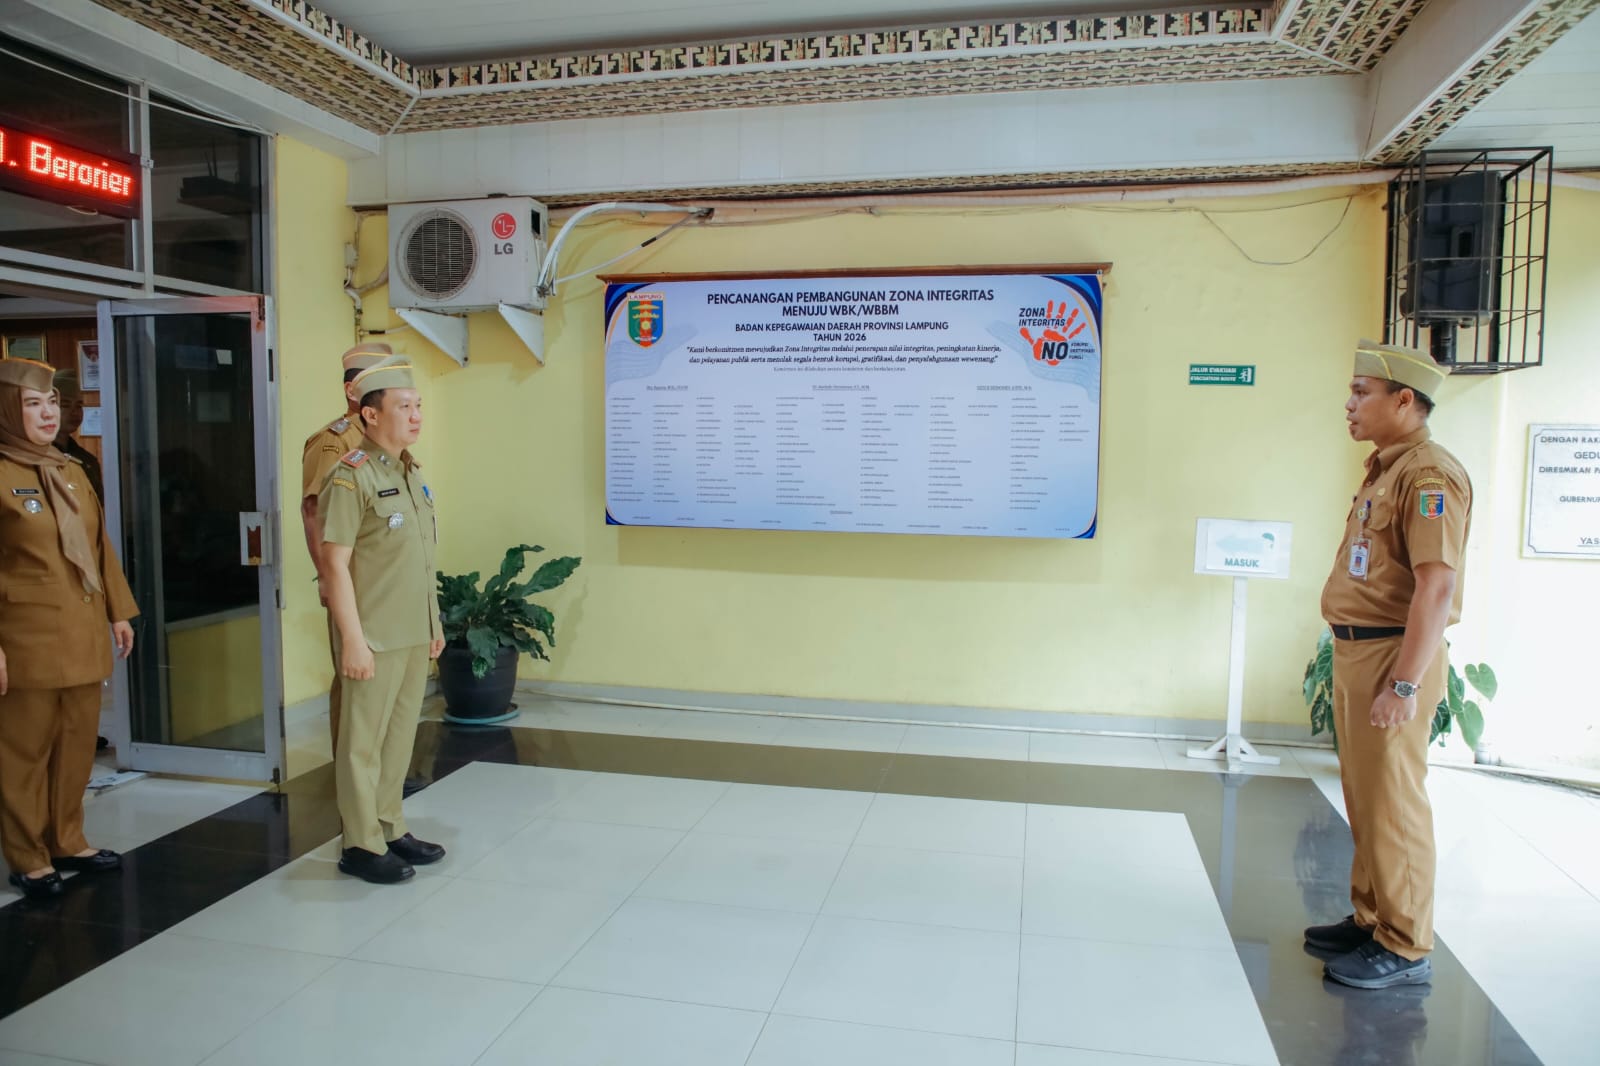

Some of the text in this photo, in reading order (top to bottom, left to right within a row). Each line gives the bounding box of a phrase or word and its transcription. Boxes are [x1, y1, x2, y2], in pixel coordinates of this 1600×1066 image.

[494, 243, 513, 255] LG
[707, 289, 994, 304] PENCANANGAN PEMBANGUNAN ZONA INTEGRITAS
[782, 304, 899, 316] MENUJU WBK/WBBM
[1019, 308, 1045, 317] ZONA
[735, 321, 949, 332] BADAN KEPEGAWAIAN DAERAH PROVINSI LAMPUNG
[813, 333, 867, 342] TAHUN 2026
[1041, 342, 1069, 360] NO
[1540, 436, 1578, 444] DENGAN
[1225, 558, 1259, 568] MASUK
